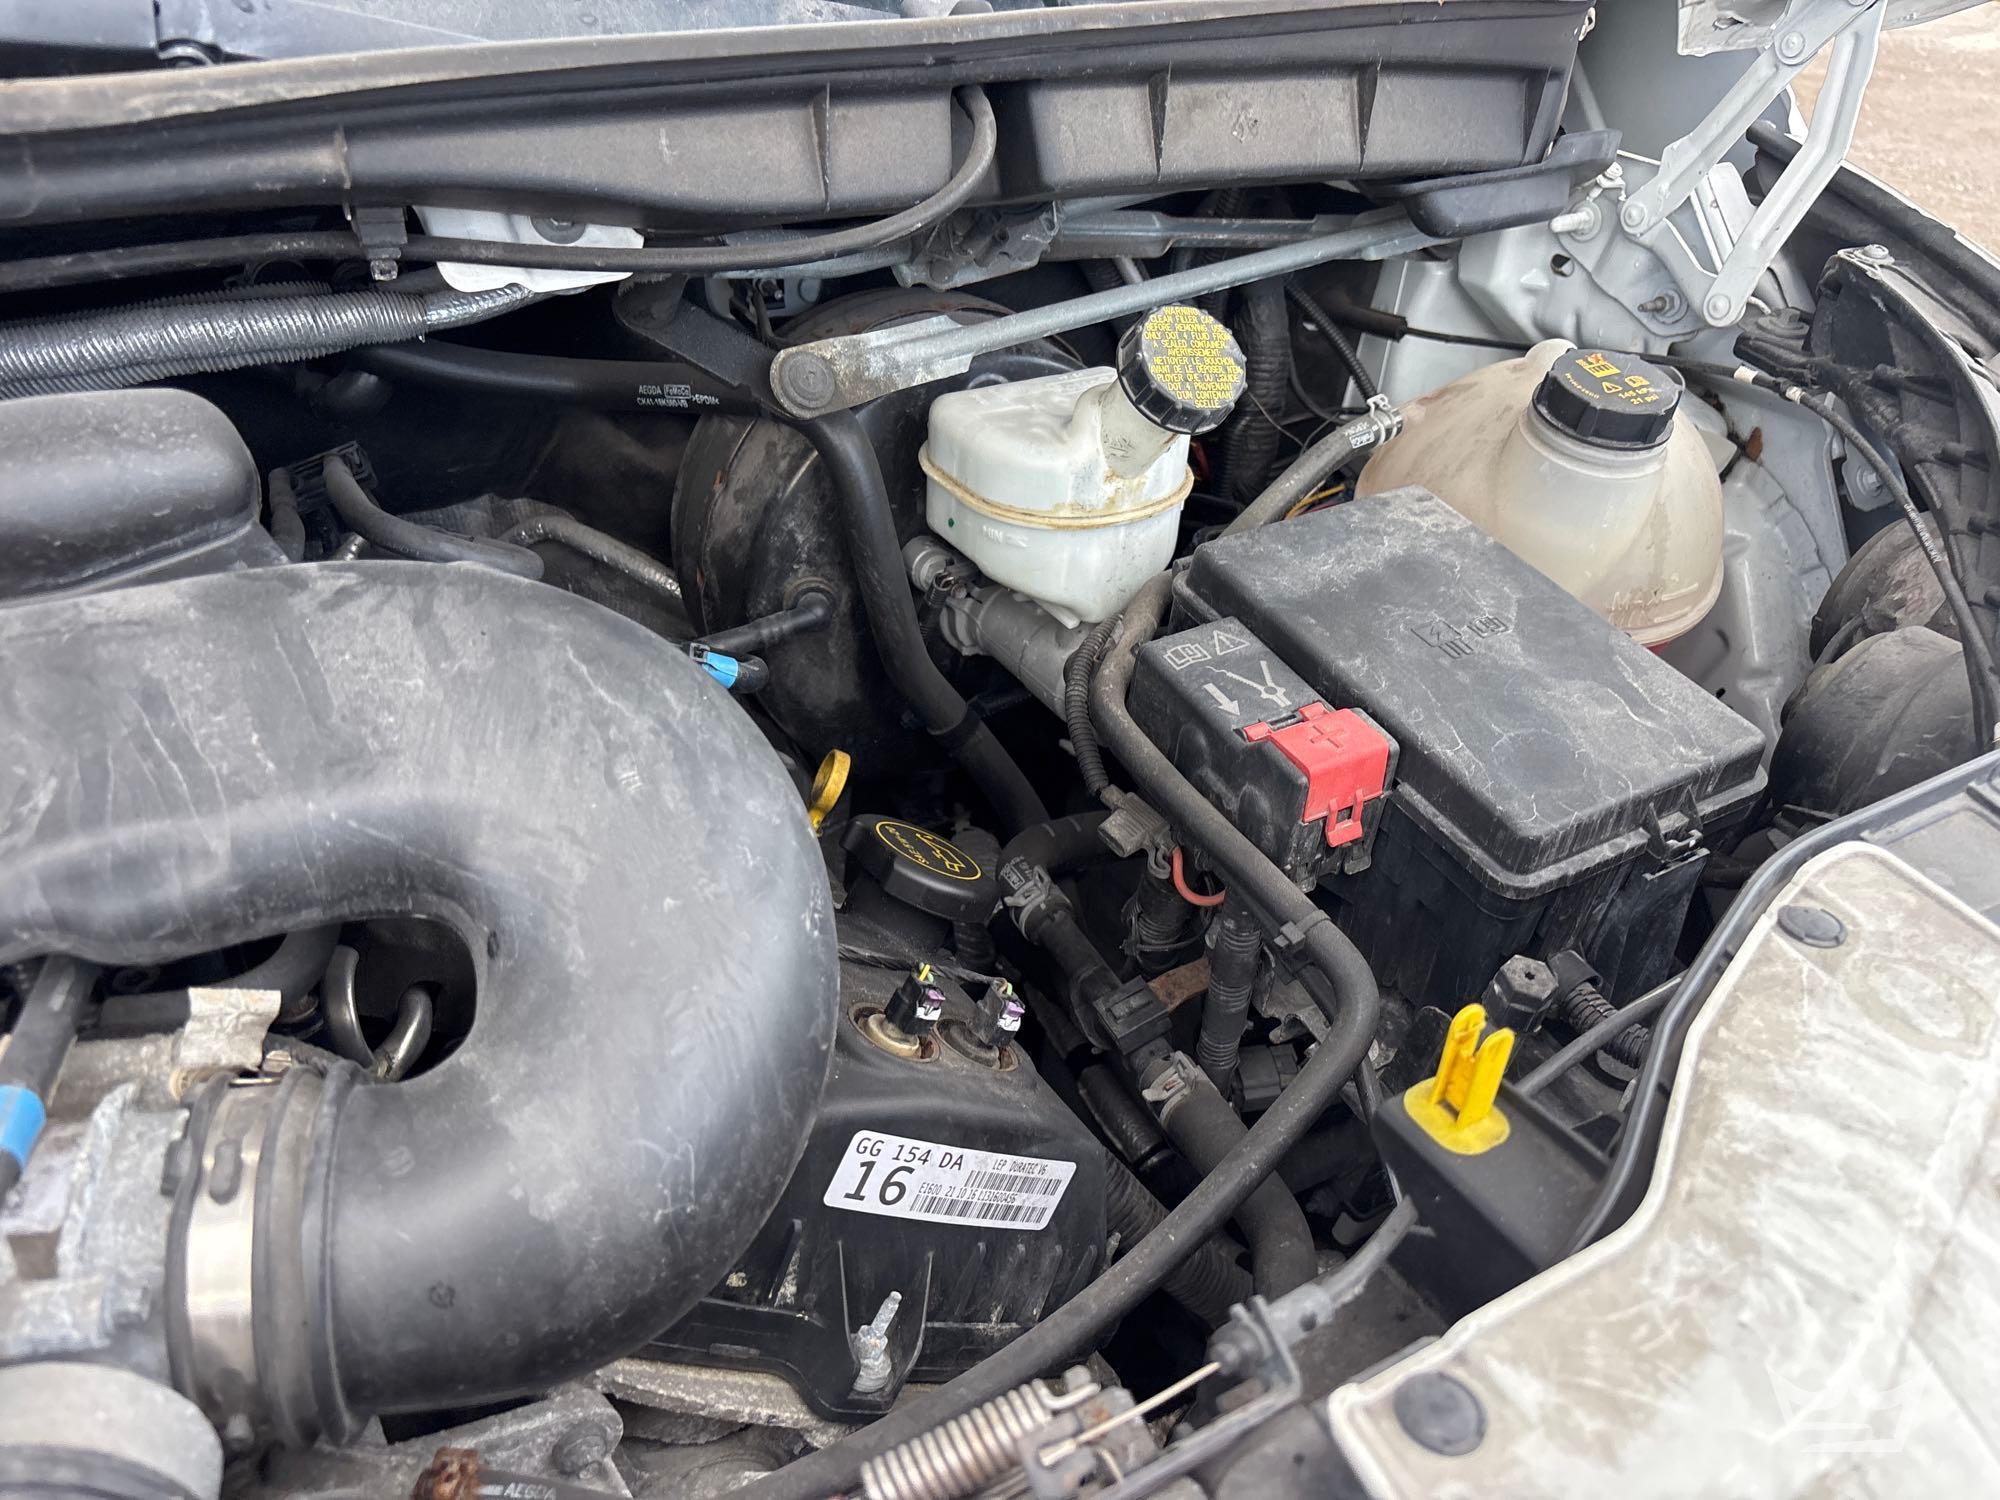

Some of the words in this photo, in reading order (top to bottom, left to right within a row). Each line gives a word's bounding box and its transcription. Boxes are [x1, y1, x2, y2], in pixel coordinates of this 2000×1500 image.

[1150, 315, 1173, 324] CLEAN
[1176, 315, 1198, 324] FILLER
[1200, 316, 1214, 324] CAP
[1146, 323, 1171, 332] BEFORE
[1144, 331, 1161, 340] ONLY
[1165, 332, 1180, 340] DOT
[1191, 332, 1210, 341] FLUID
[1153, 340, 1159, 348] A
[1161, 340, 1188, 348] SEALED
[1153, 356, 1190, 365] NETTOYER
[1191, 357, 1202, 365] LE
[1203, 357, 1236, 366] BOUCHON
[1150, 365, 1171, 374] AVANT
[1173, 365, 1183, 373] DE
[1185, 365, 1194, 373] LE
[1156, 374, 1184, 382] PLOYER
[1187, 374, 1201, 382] QUE
[1203, 374, 1213, 382] DU
[1167, 382, 1182, 391] DOT
[1194, 382, 1233, 391] PROVENANT
[1195, 391, 1234, 400] CONTENANT
[1630, 397, 1643, 405] 21
[856, 1137, 885, 1157] GG
[892, 1144, 932, 1166] 154
[938, 1152, 964, 1171] DA
[1008, 1160, 1039, 1175] DURATEC
[843, 1160, 915, 1206] 16
[945, 1186, 956, 1198] 21
[956, 1187, 968, 1199] 10
[967, 1189, 979, 1200] 16
